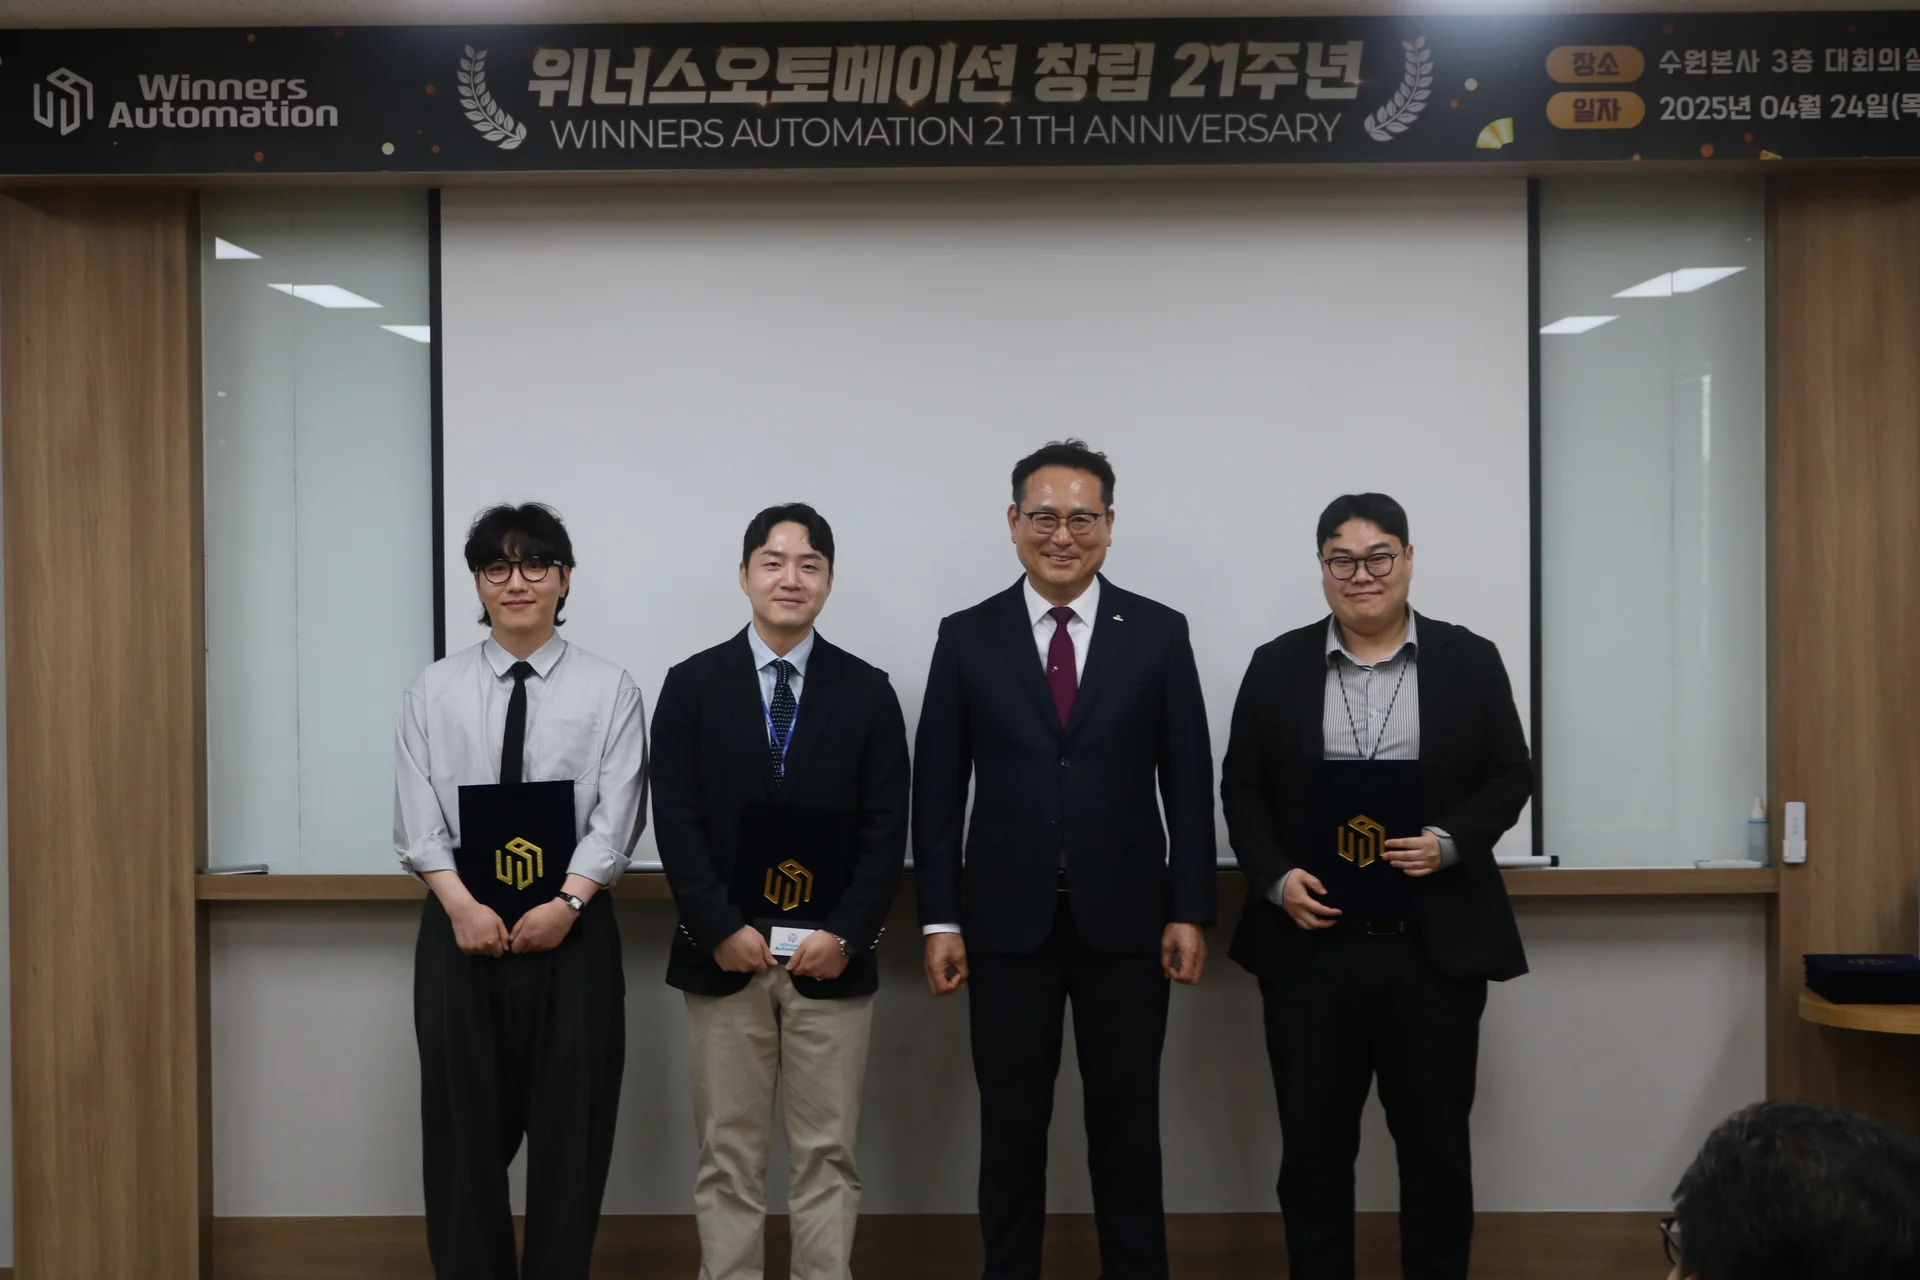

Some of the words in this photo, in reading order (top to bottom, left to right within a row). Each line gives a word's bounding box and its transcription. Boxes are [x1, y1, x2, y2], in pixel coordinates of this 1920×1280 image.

[527, 43, 1018, 106] 위너스오토메이션
[1034, 42, 1155, 102] 창립
[1169, 41, 1364, 100] 21주년
[1572, 51, 1620, 77] 장소
[1658, 49, 1760, 75] 수원본사
[1771, 48, 1814, 73] 3층
[138, 74, 308, 101] Winners
[108, 100, 338, 129] Automation
[1572, 98, 1622, 122] 일자
[1659, 95, 1752, 121] 2025년
[1760, 94, 1822, 120] 04월
[550, 118, 724, 149] WINNERS
[731, 116, 973, 148] AUTOMATION
[1083, 112, 1342, 145] ANNIVERSARY
